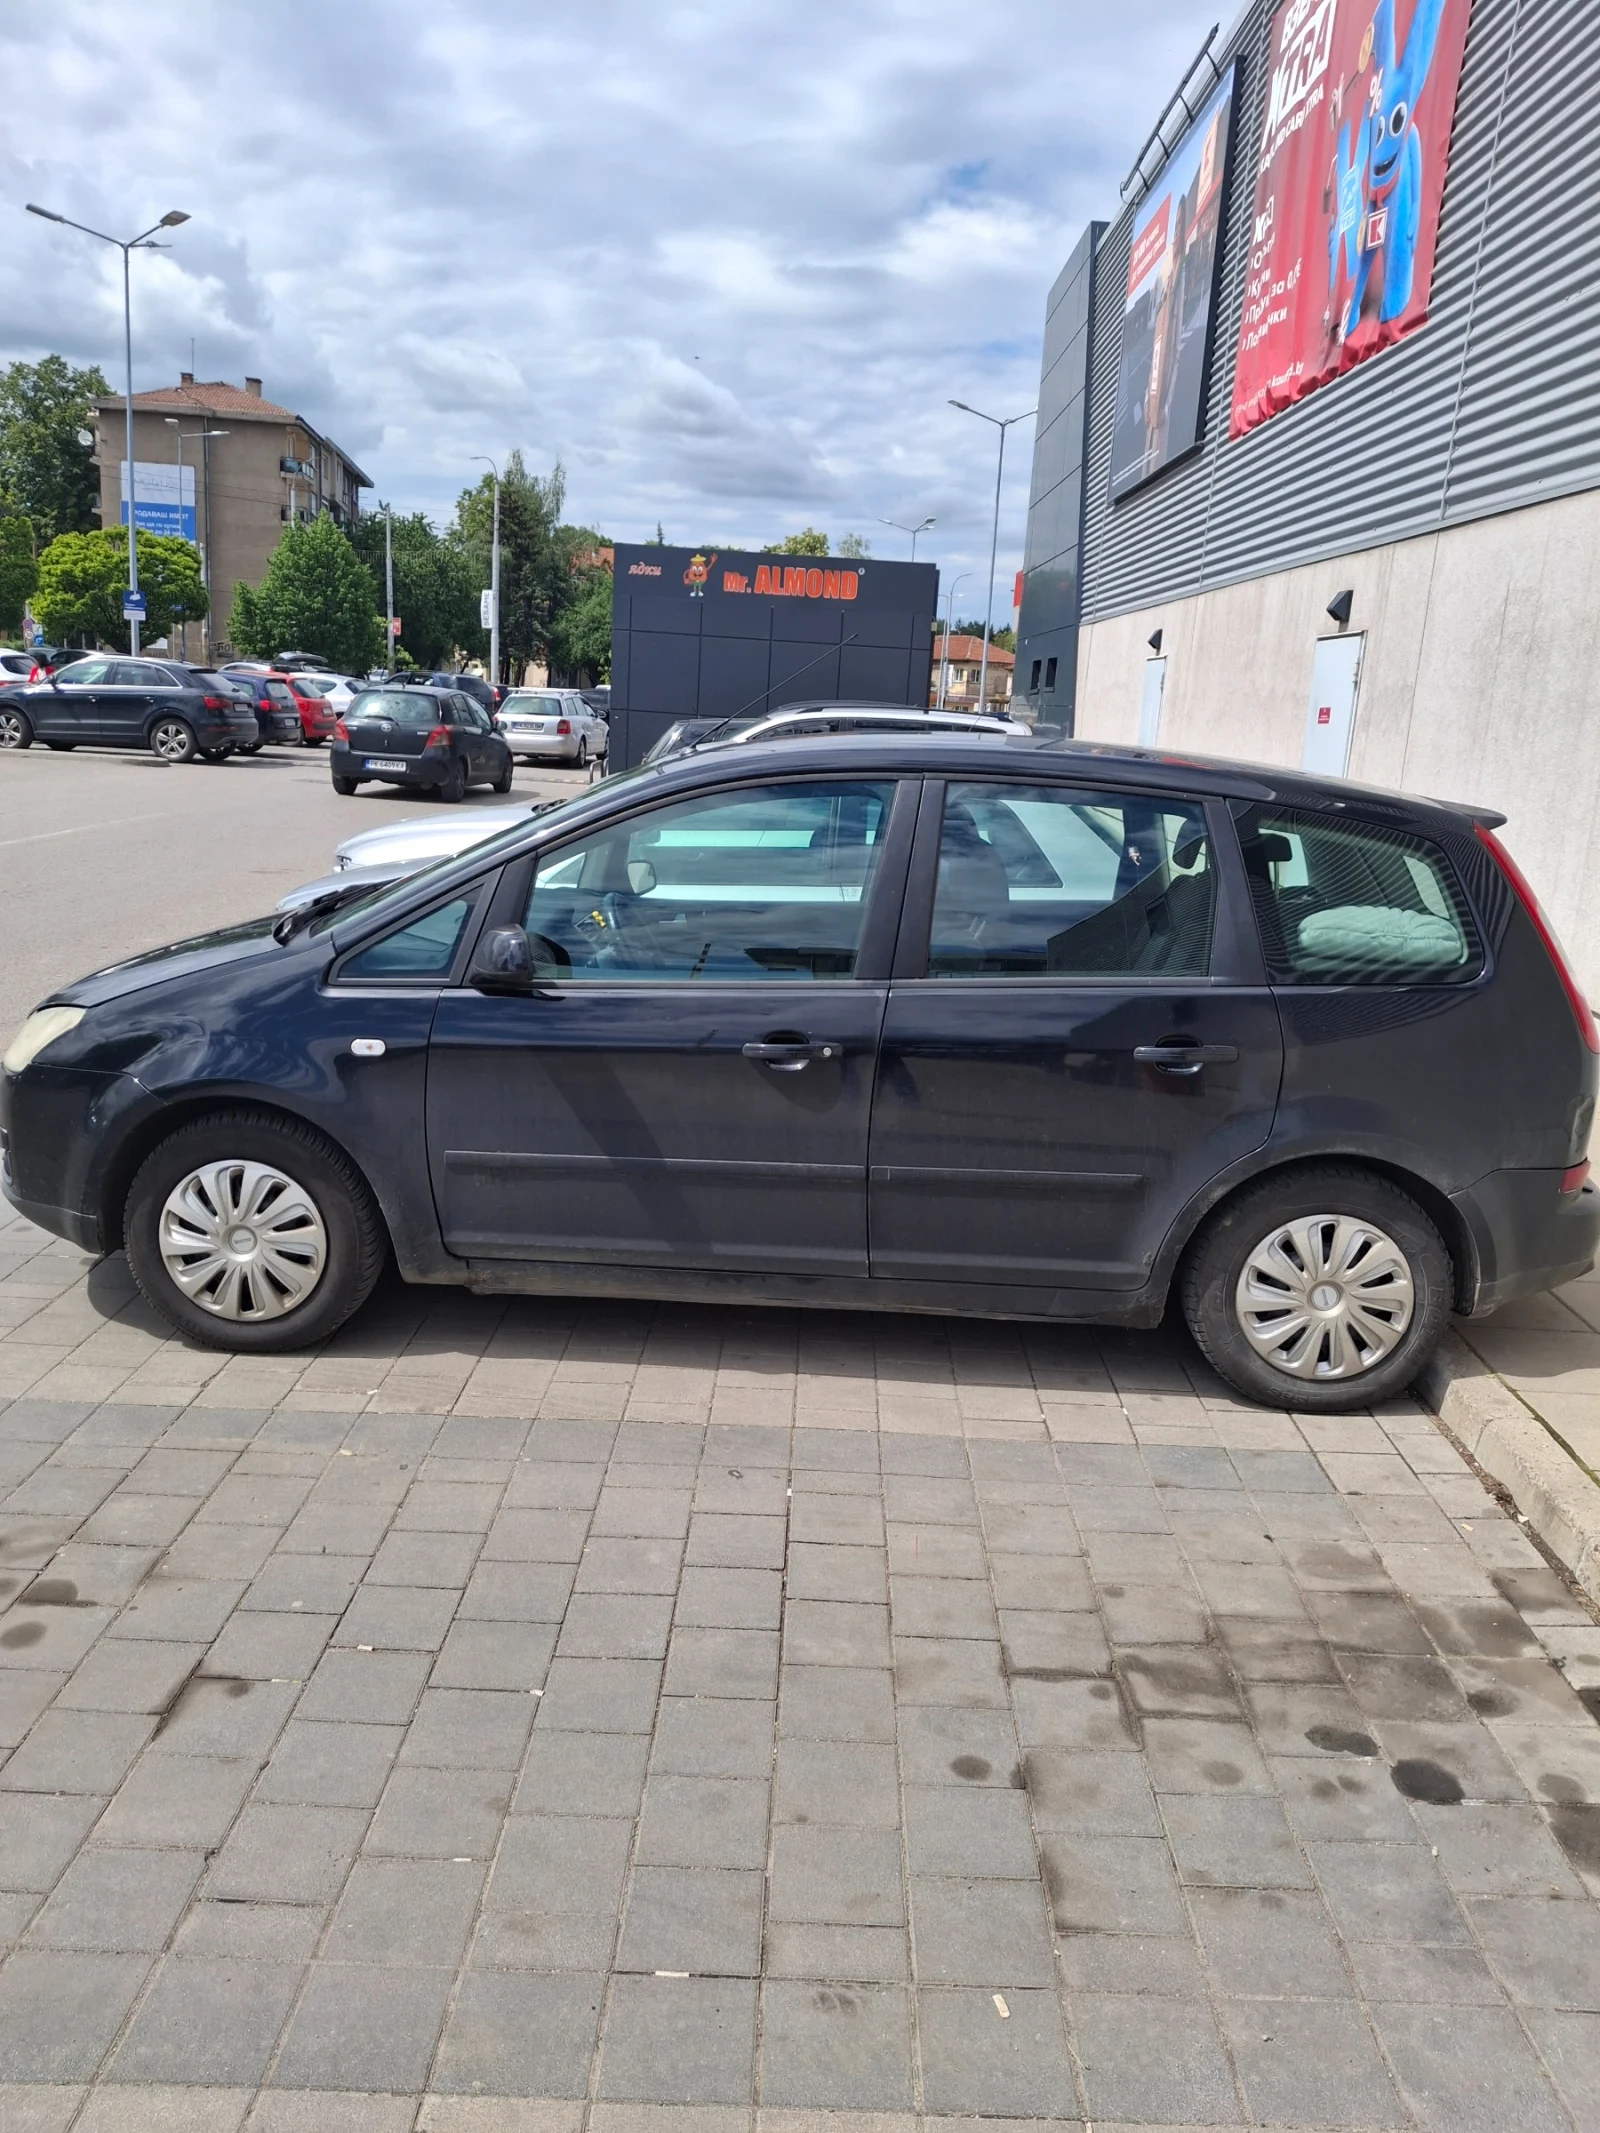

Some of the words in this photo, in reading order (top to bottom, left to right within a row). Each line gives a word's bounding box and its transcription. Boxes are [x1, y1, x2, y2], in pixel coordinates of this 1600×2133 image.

[1271, 279, 1285, 298] за
[723, 571, 751, 593] Mr.
[754, 565, 859, 600] ALMOND
